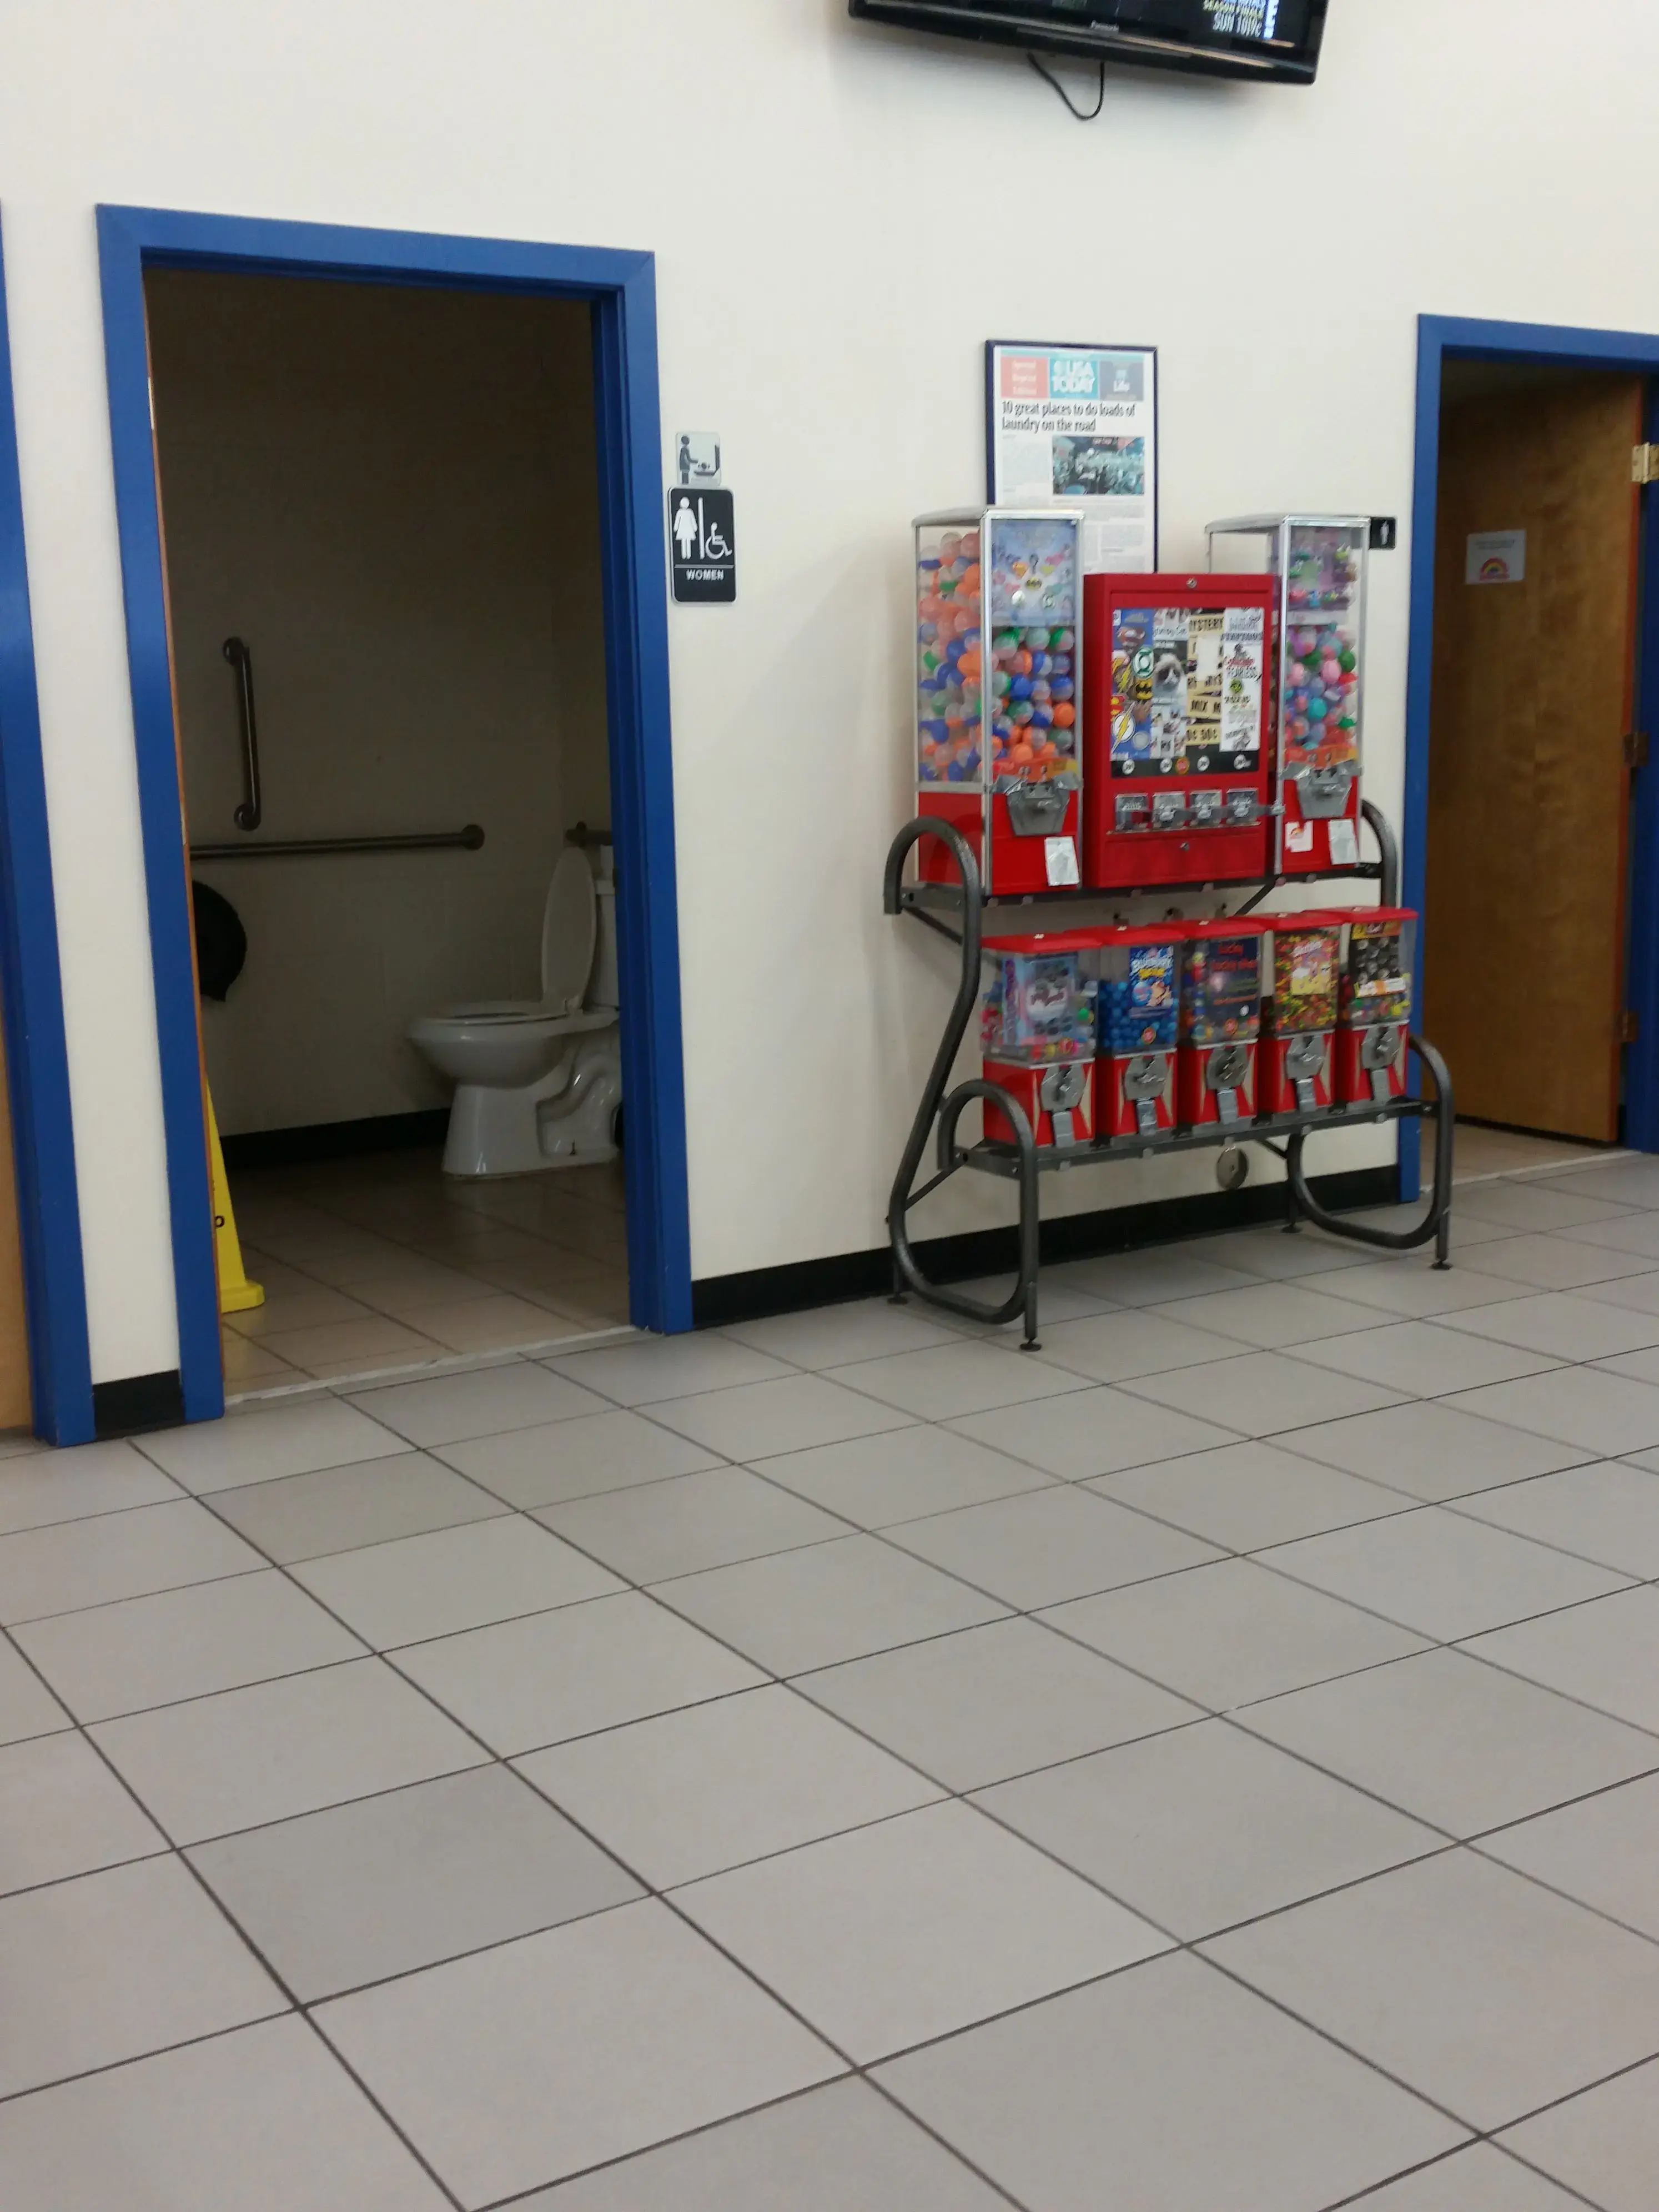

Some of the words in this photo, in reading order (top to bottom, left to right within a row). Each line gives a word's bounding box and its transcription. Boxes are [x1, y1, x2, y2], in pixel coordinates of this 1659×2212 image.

[1213, 12, 1235, 33] SUN
[1002, 400, 1013, 414] 10
[1014, 402, 1039, 416] great
[1042, 401, 1072, 418] places
[1073, 402, 1083, 415] to
[1085, 401, 1098, 416] do
[1099, 402, 1124, 417] loads
[1125, 403, 1135, 417] of
[1002, 416, 1039, 434] laundry
[1042, 421, 1055, 431] on
[1057, 418, 1072, 431] the
[1074, 418, 1097, 433] road
[686, 569, 724, 581] WOMEN
